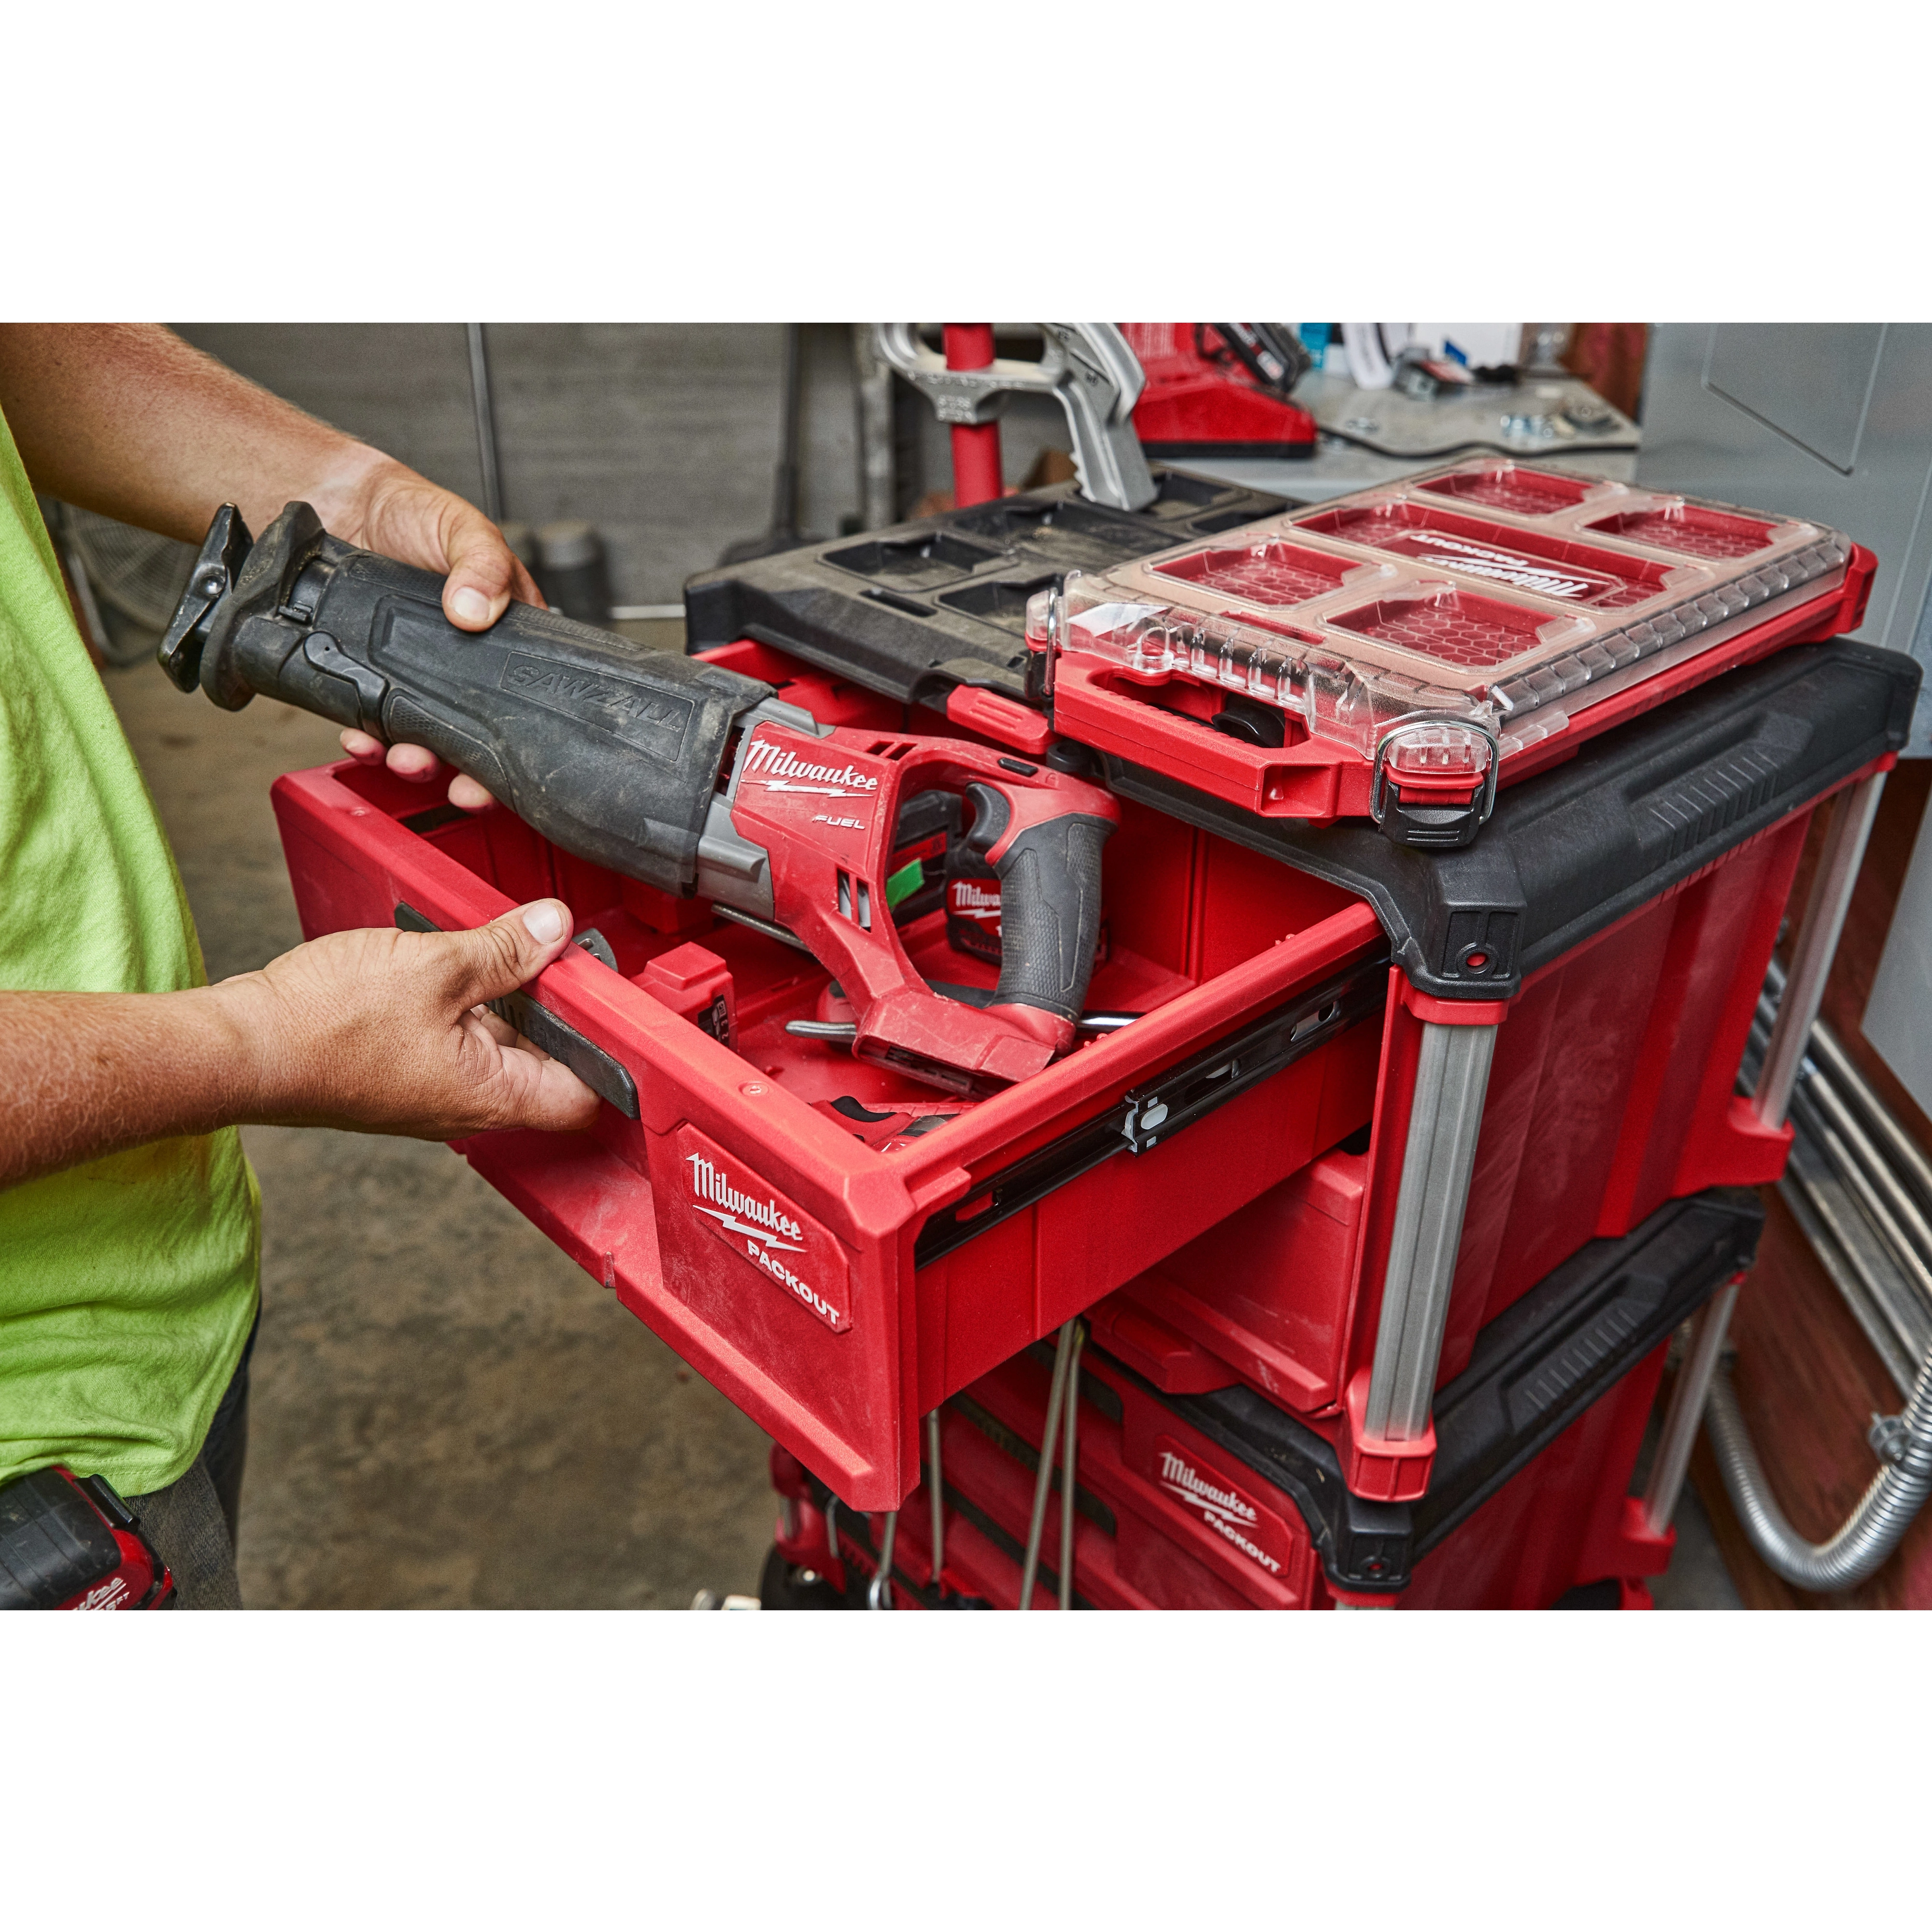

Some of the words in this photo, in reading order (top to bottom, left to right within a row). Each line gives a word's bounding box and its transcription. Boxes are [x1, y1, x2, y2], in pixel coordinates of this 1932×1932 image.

[1410, 534, 1529, 567] PACKOUT
[508, 664, 682, 732] SAWZALL
[745, 739, 879, 791] Milwaukee
[812, 814, 866, 830] FUEL
[686, 1153, 803, 1241] Milwaukee
[747, 1240, 840, 1324] PACKOUT
[1159, 1451, 1258, 1521] Milwaukee
[1203, 1510, 1281, 1573] PACKOUT
